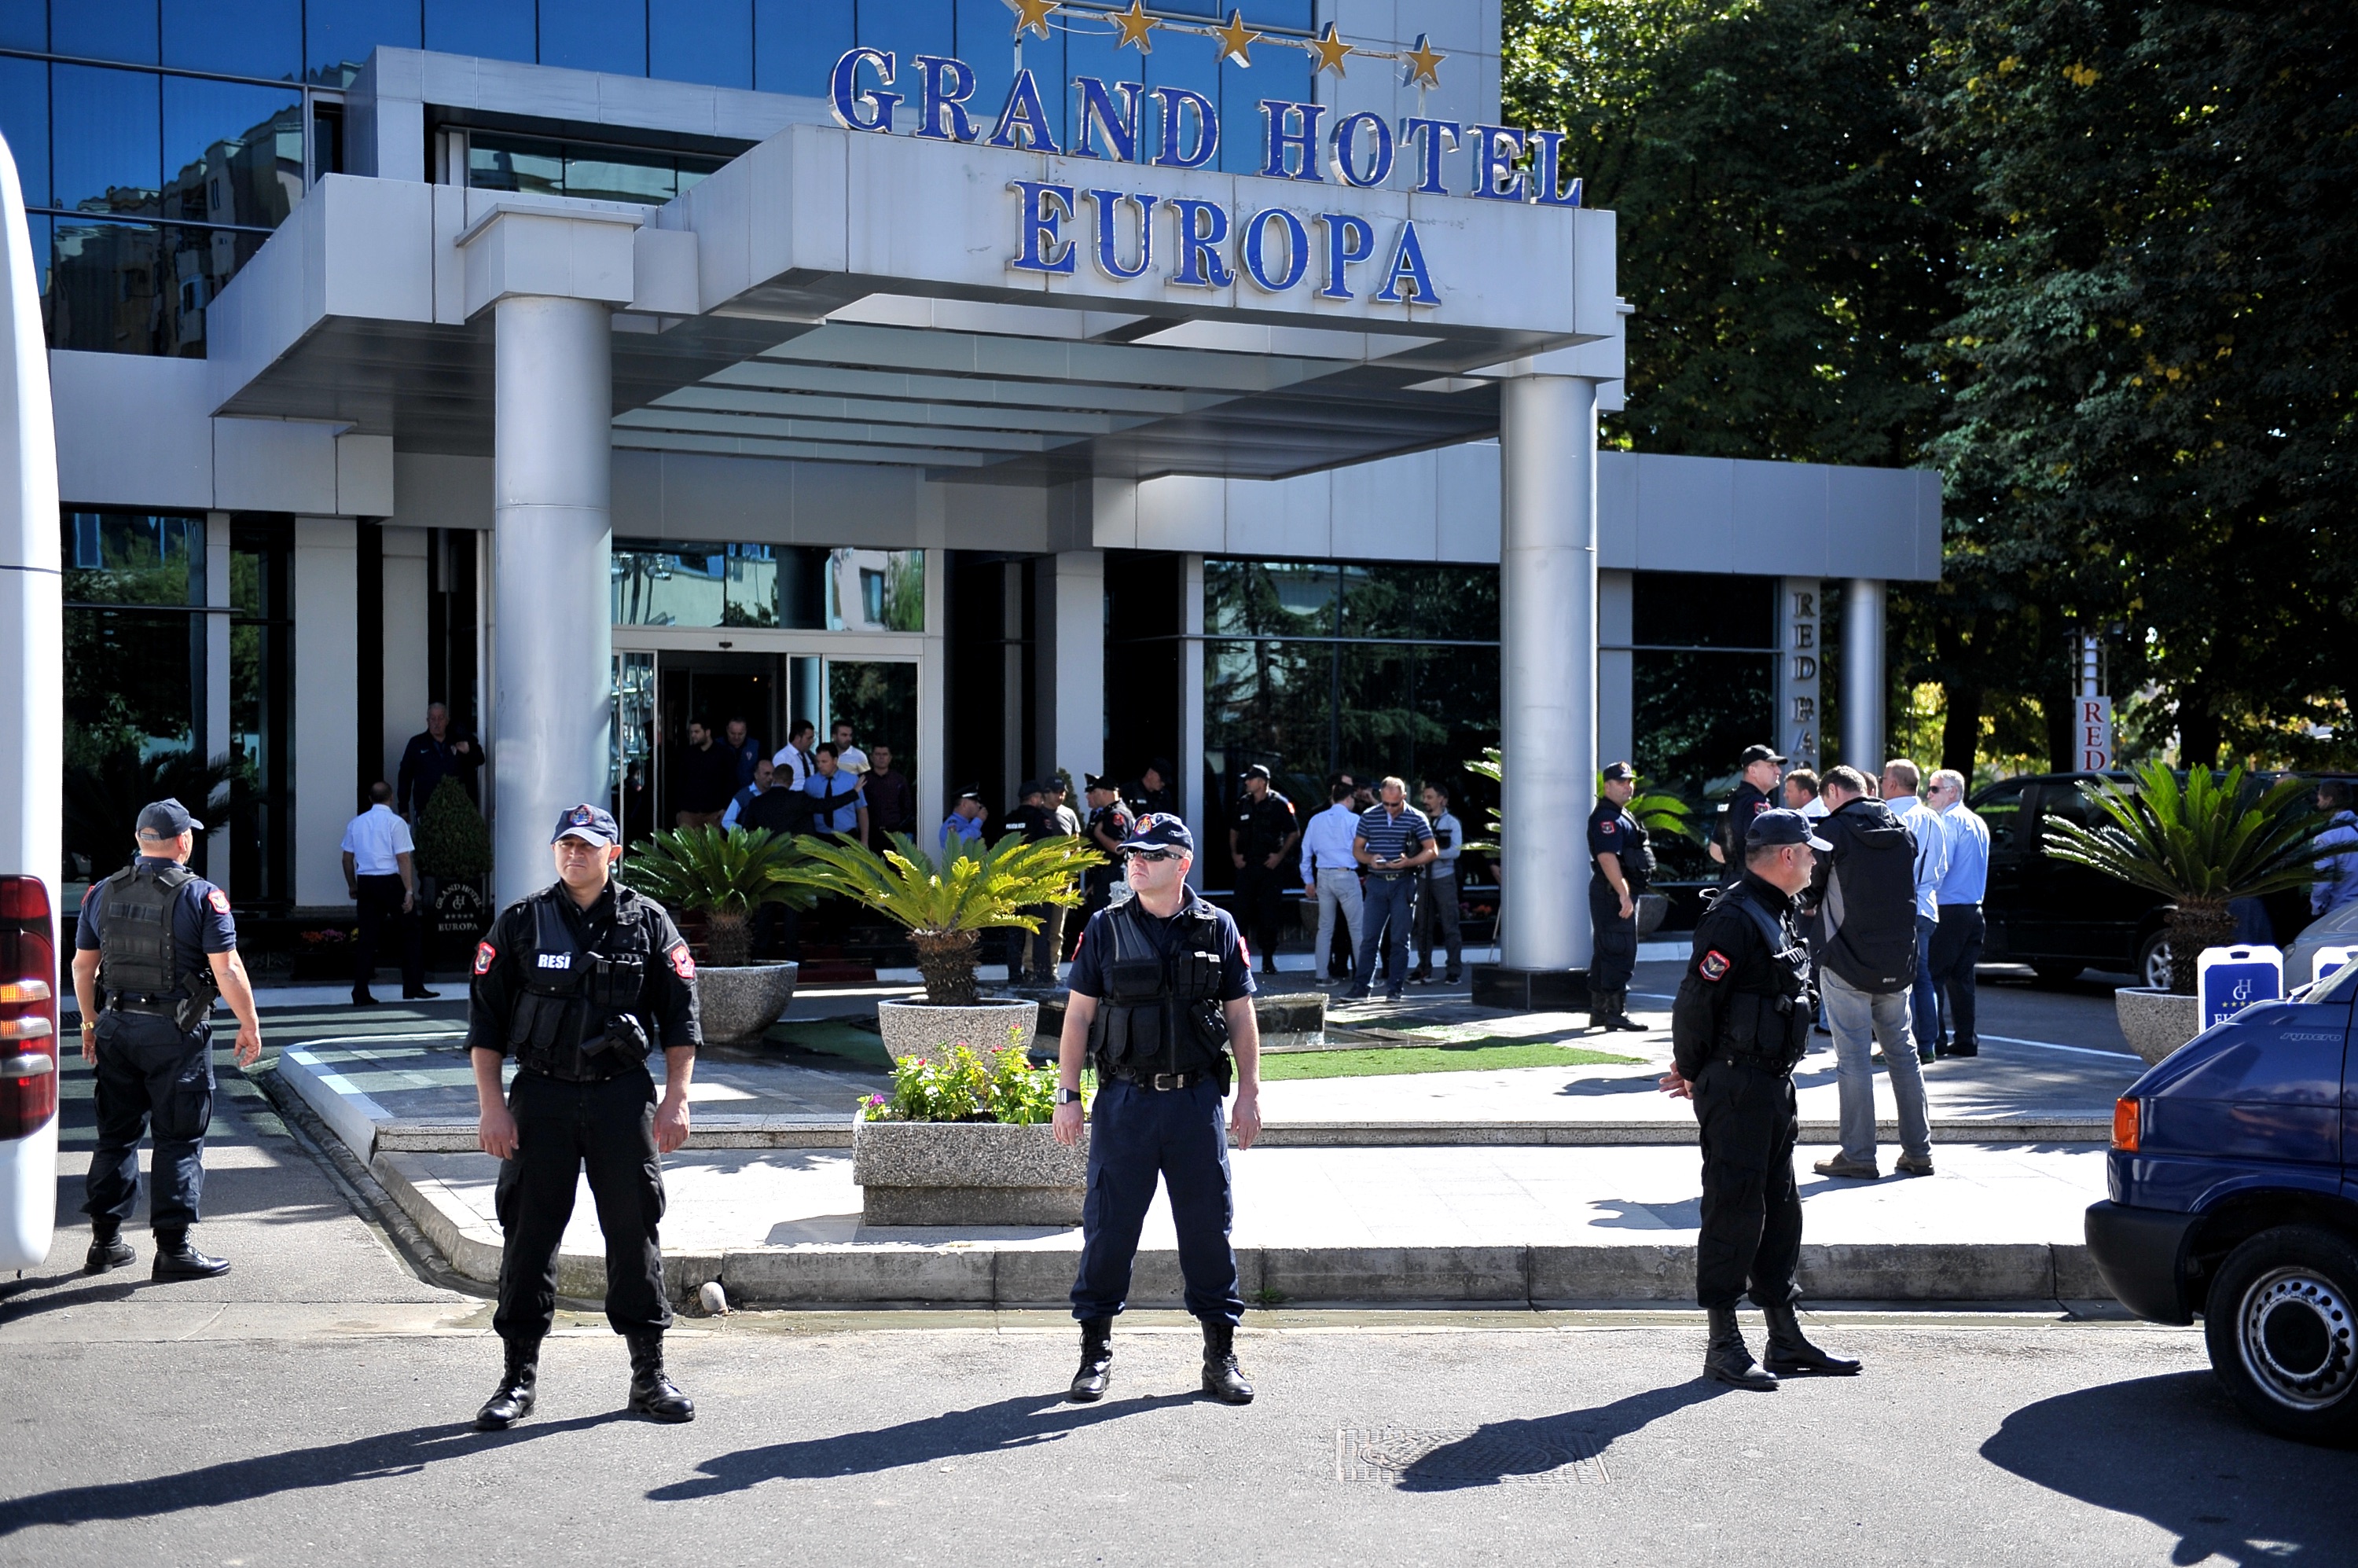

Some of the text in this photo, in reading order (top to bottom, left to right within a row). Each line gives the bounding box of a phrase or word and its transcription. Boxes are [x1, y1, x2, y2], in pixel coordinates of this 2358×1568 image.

[828, 46, 1583, 208] GRAND HOTEL
[1006, 179, 1442, 308] EUROPA
[1792, 591, 1816, 681] RED
[2083, 702, 2106, 771] RED
[435, 883, 482, 909] GRAND HOTEL
[438, 923, 479, 931] EUROPA
[538, 954, 571, 969] RESI
